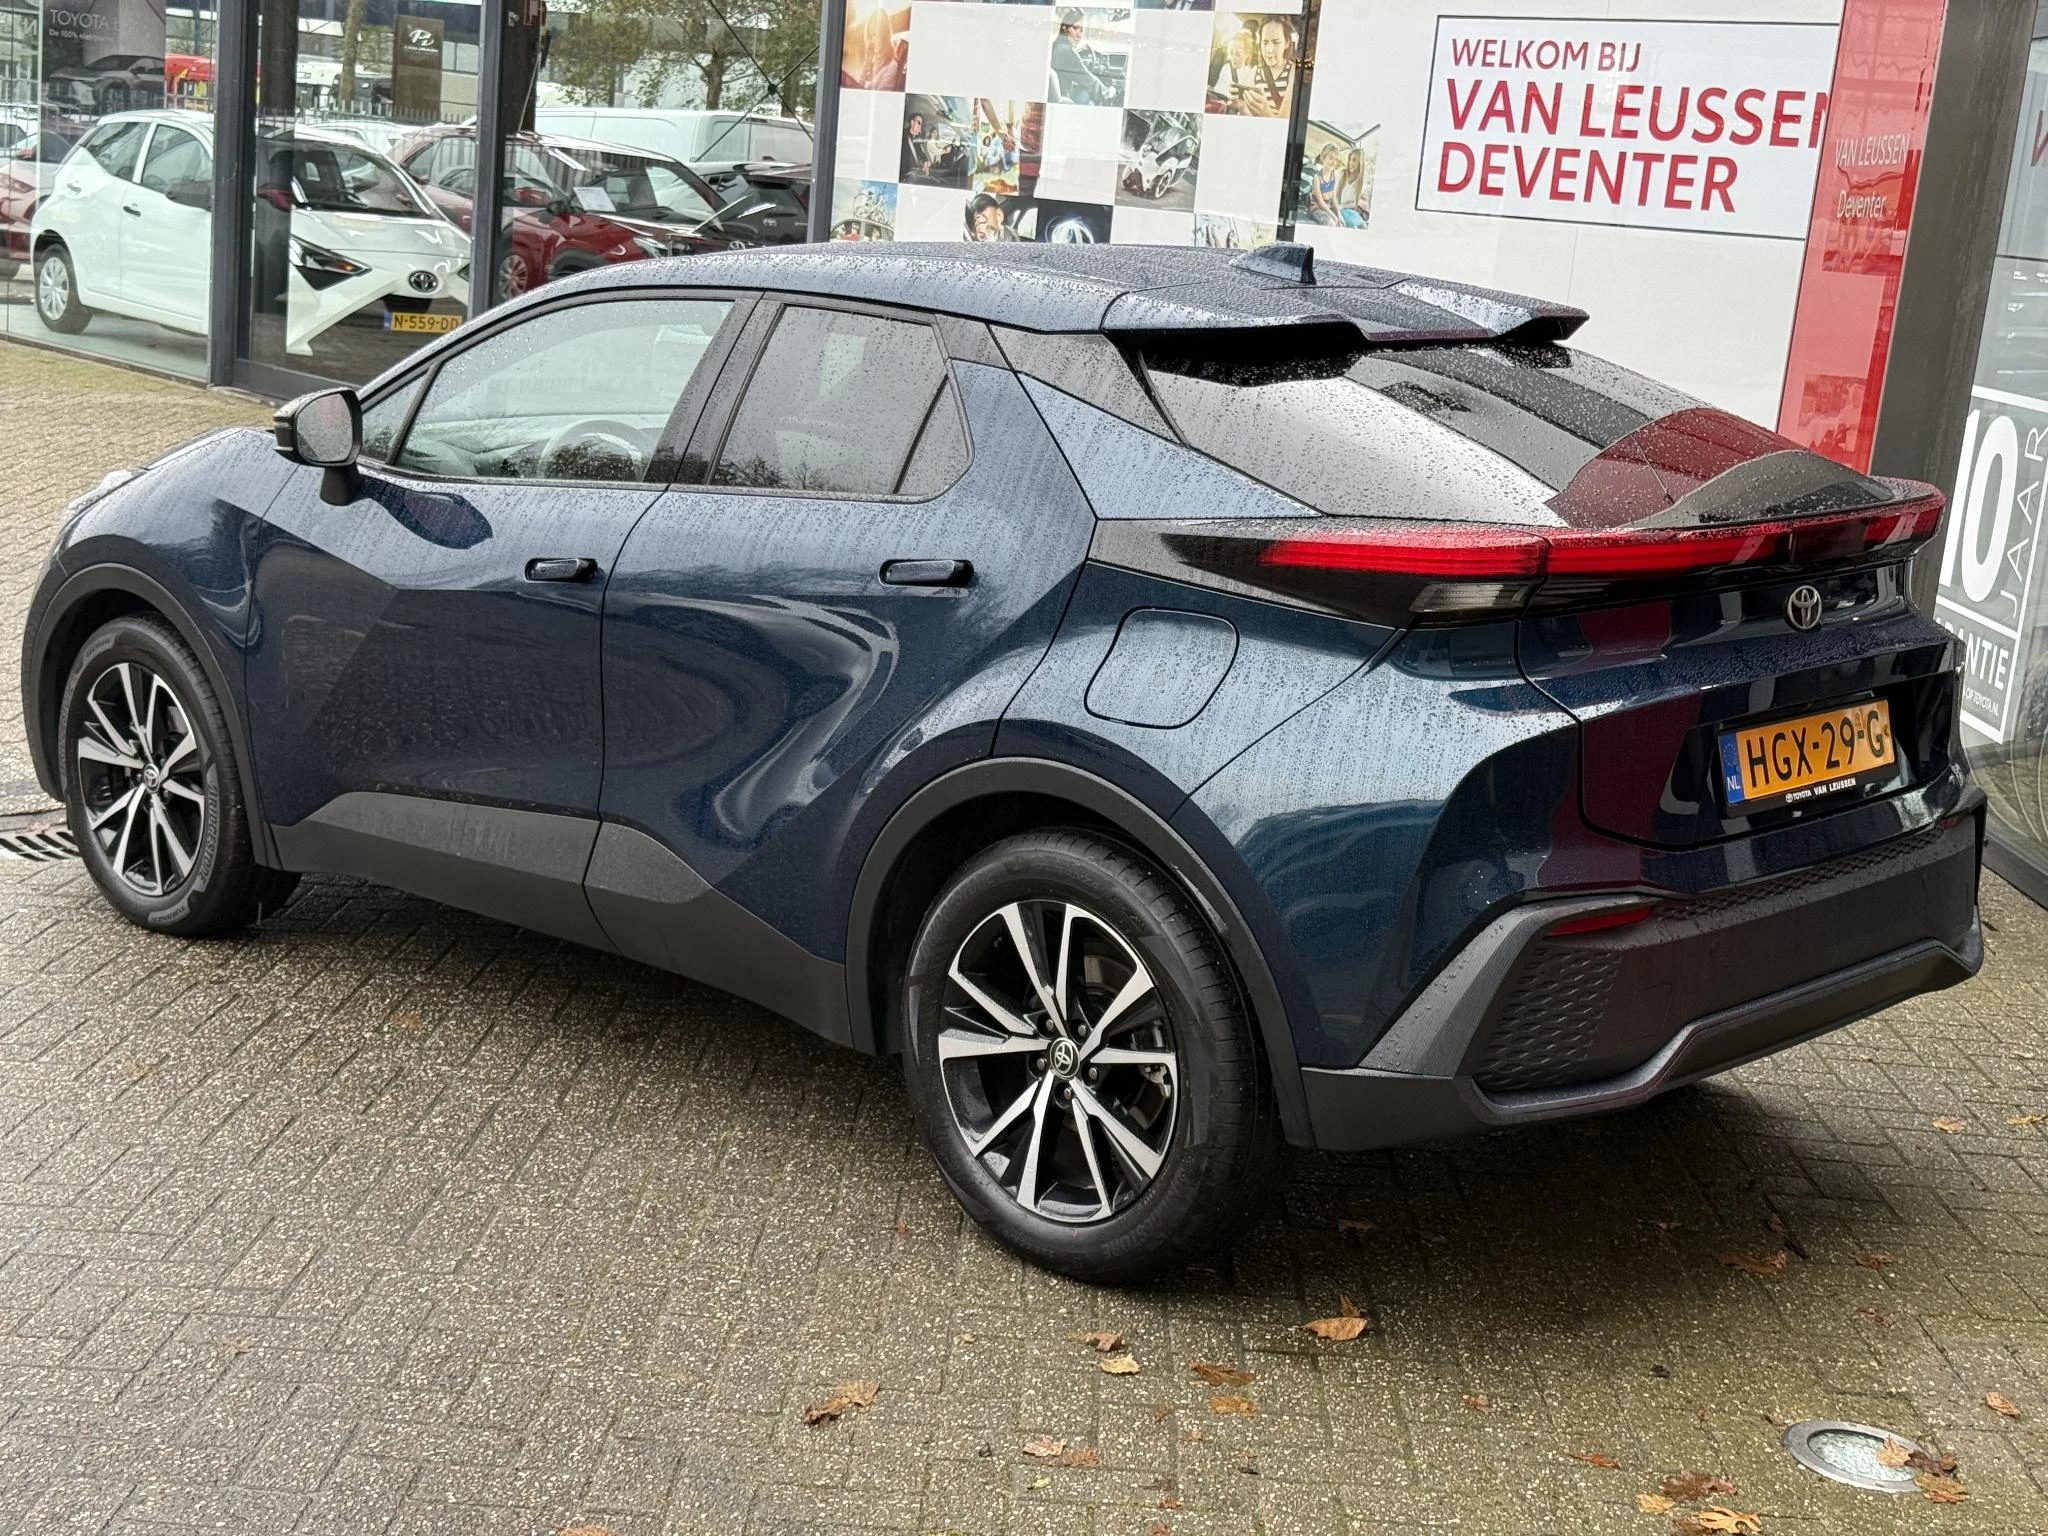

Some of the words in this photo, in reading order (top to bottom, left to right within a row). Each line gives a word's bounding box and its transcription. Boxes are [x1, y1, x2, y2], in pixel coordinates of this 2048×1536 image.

[50, 8, 109, 29] TOYOTA
[1451, 38, 1589, 71] WELKOM
[1597, 42, 1642, 73] BIJ
[1446, 78, 1563, 135] VAN
[1835, 138, 1857, 167] VAN
[1858, 133, 1911, 166] LEUSSEN
[1437, 141, 1738, 213] DEVENTER
[1836, 190, 1887, 218] Deventer
[1939, 409, 2018, 602] 10
[2000, 427, 2048, 618] JAAR
[1746, 710, 1885, 788] HGX-29-G
[1727, 776, 1741, 791] NL
[1793, 788, 1811, 800] TOYOTA
[1814, 784, 1827, 796] VAN
[1829, 778, 1856, 792] LEUSSEN
